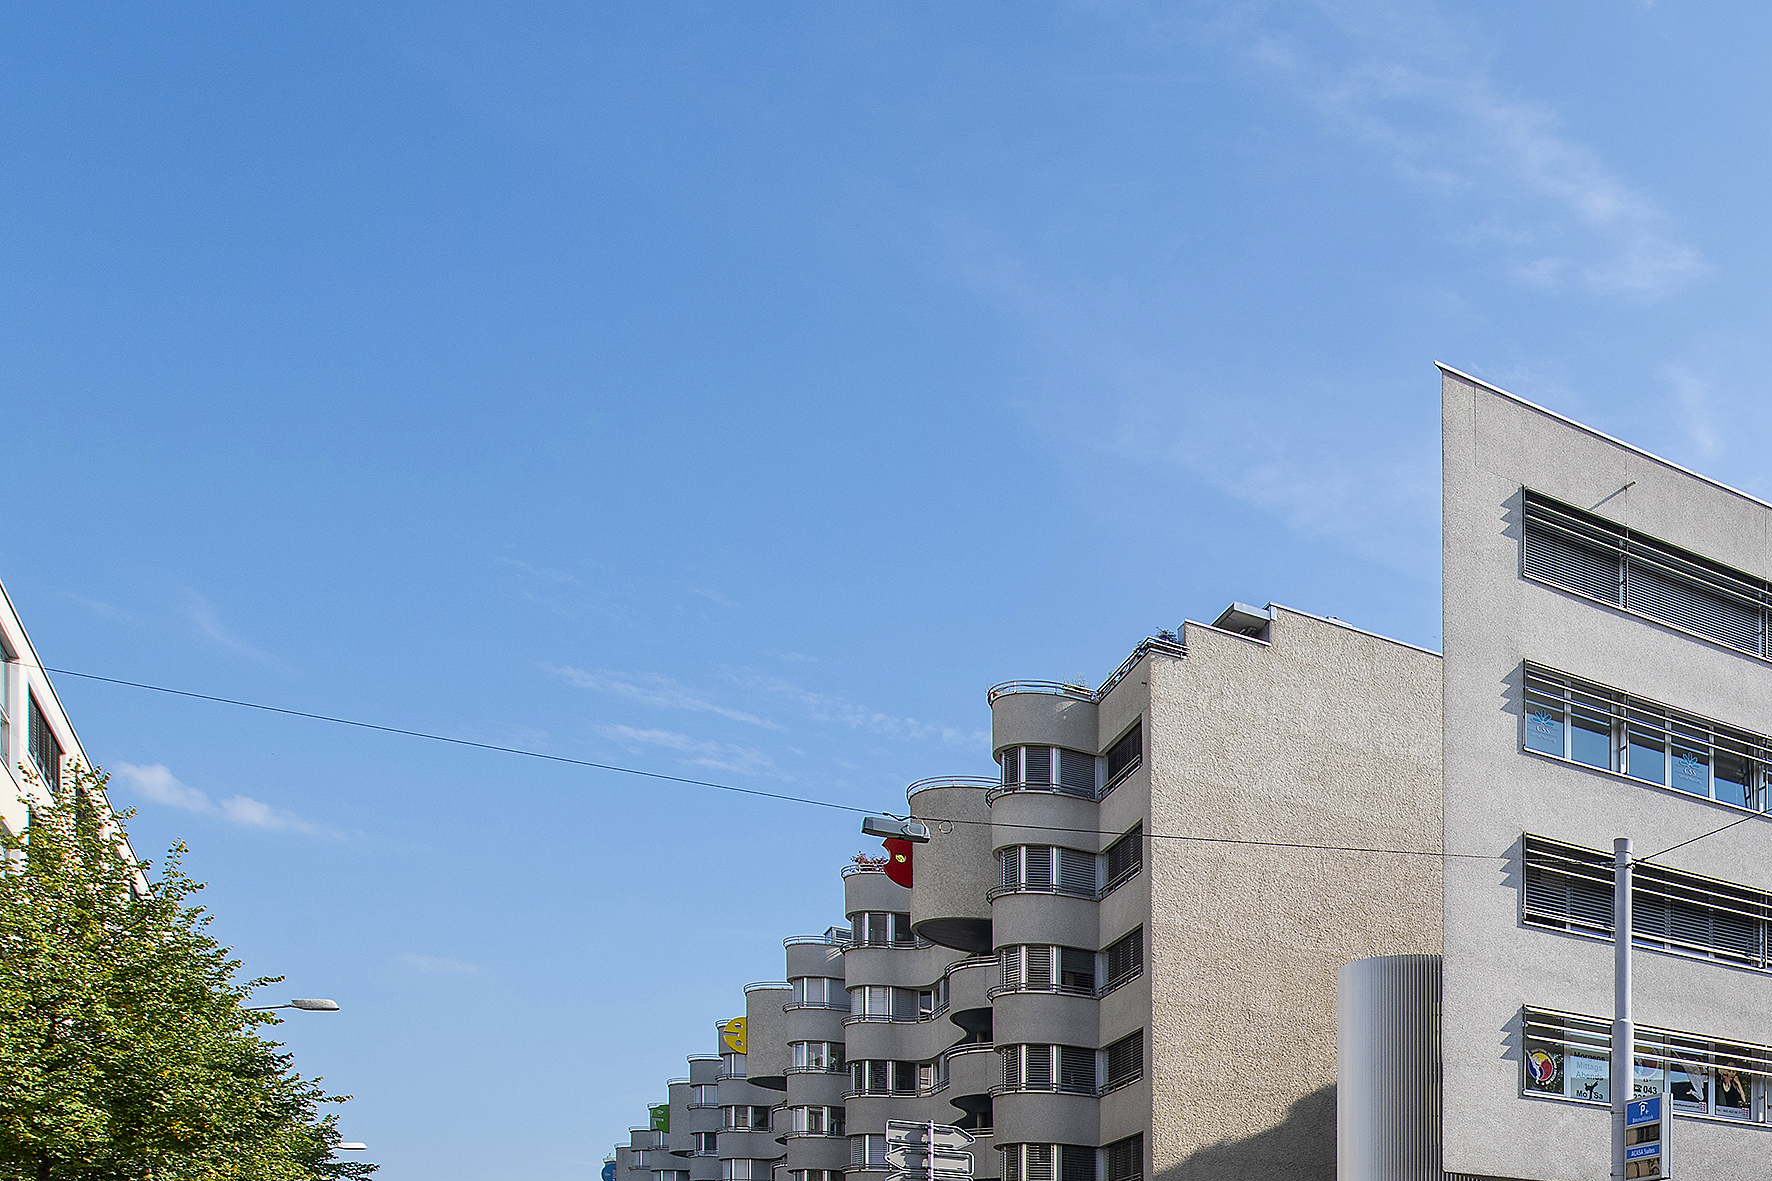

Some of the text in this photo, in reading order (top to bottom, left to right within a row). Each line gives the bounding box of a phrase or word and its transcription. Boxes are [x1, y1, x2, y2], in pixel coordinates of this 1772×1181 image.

[1576, 1062, 1603, 1072] Mittags
[1576, 1090, 1588, 1098] Mo
[1643, 1086, 1657, 1095] 043
